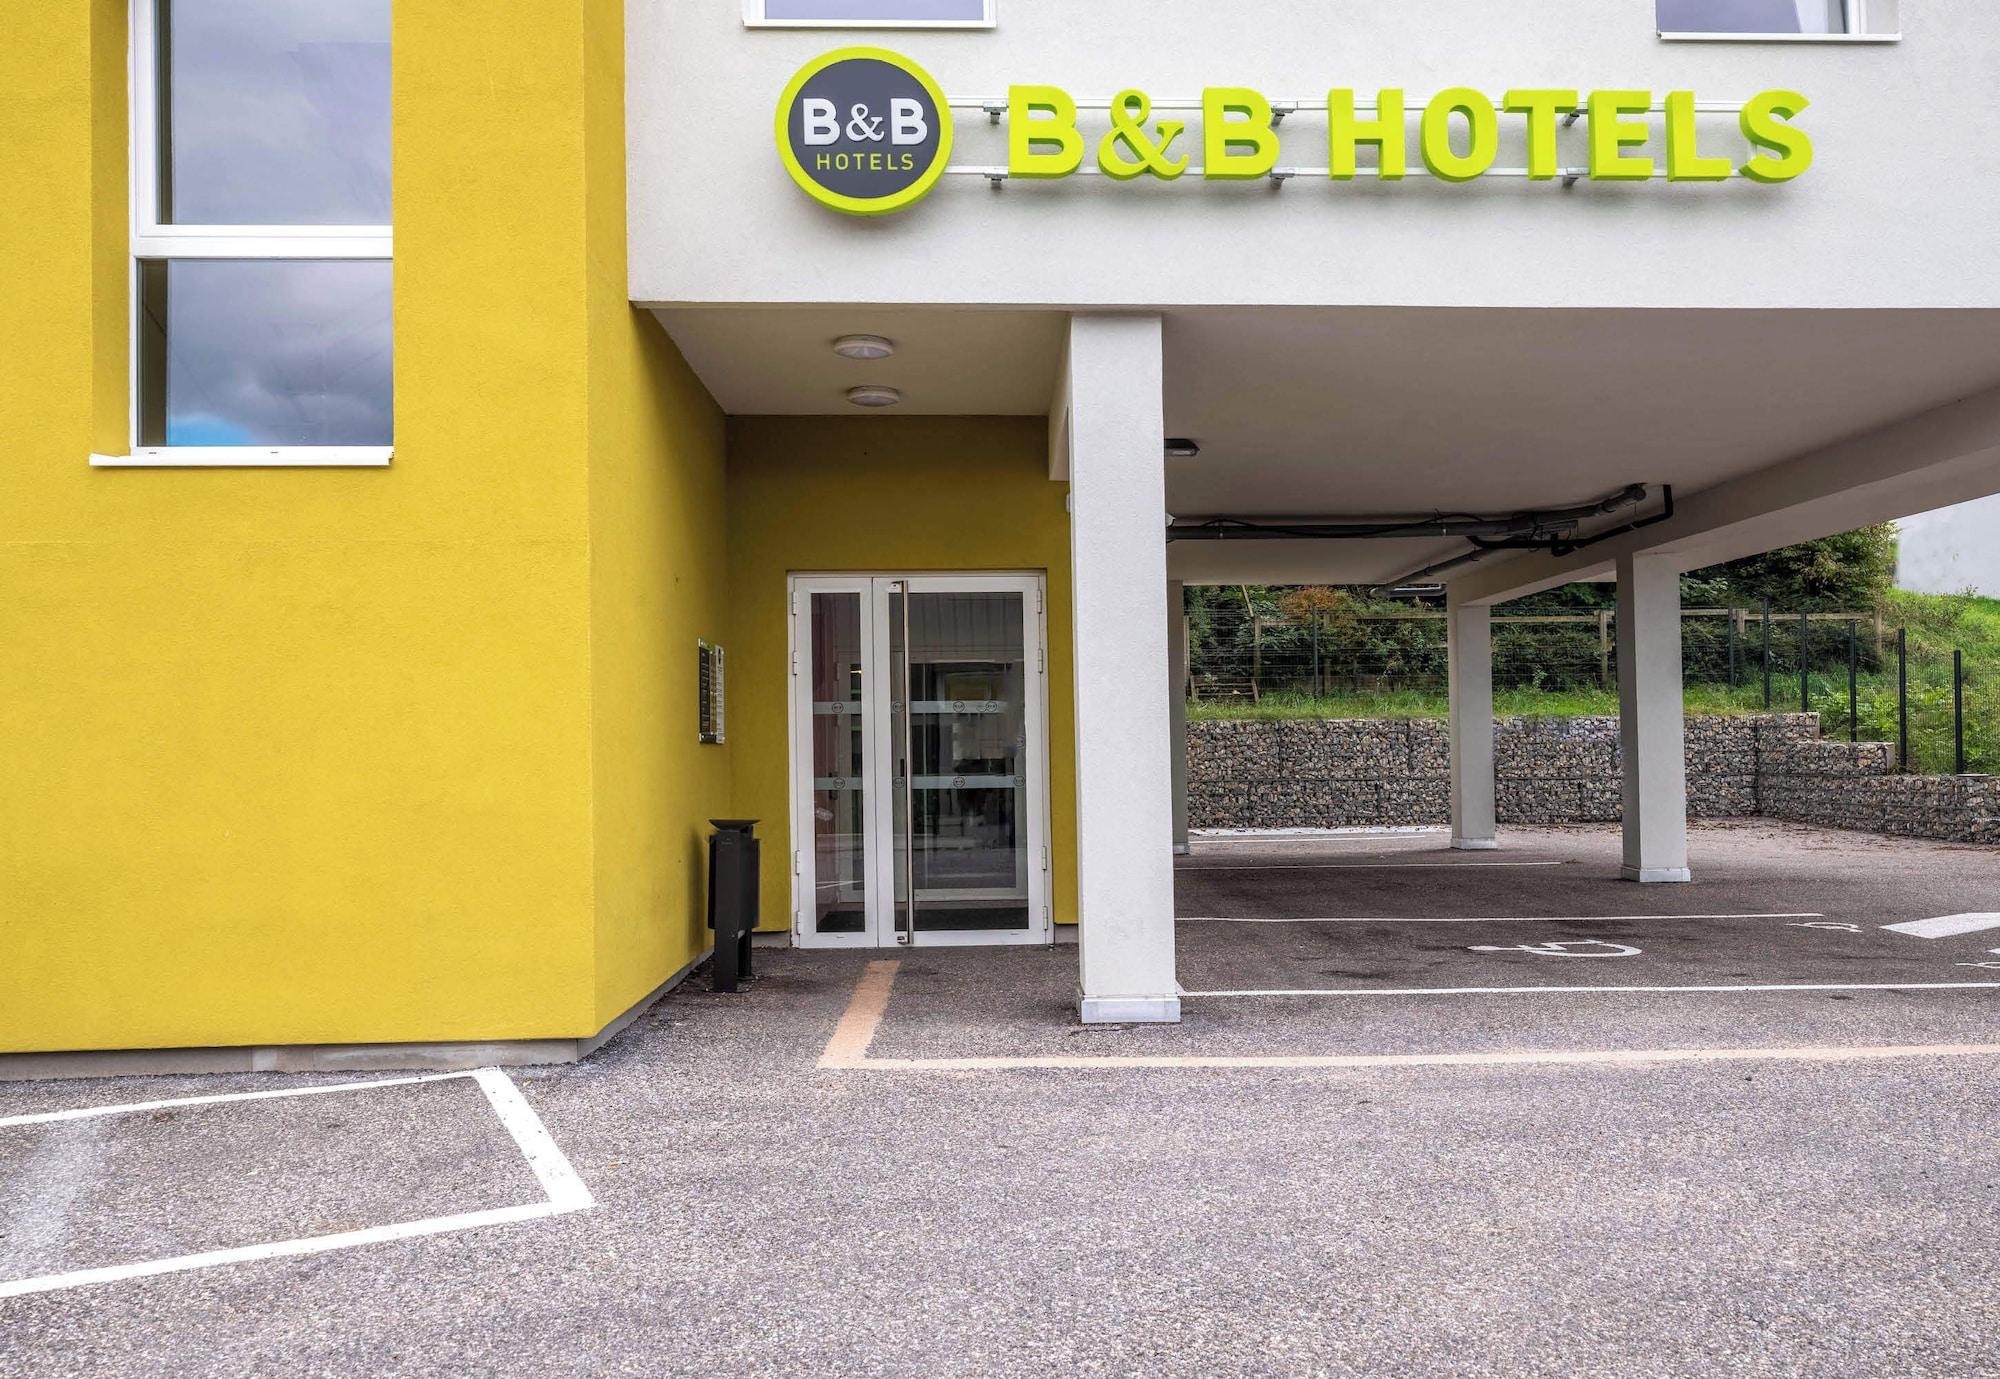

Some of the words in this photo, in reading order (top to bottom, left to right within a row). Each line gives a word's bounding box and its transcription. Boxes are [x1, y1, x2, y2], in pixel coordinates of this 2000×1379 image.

[803, 98, 928, 146] B&B
[1009, 85, 1280, 181] B&B
[1328, 87, 1814, 184] HOTELS
[816, 153, 914, 171] HOTELS
